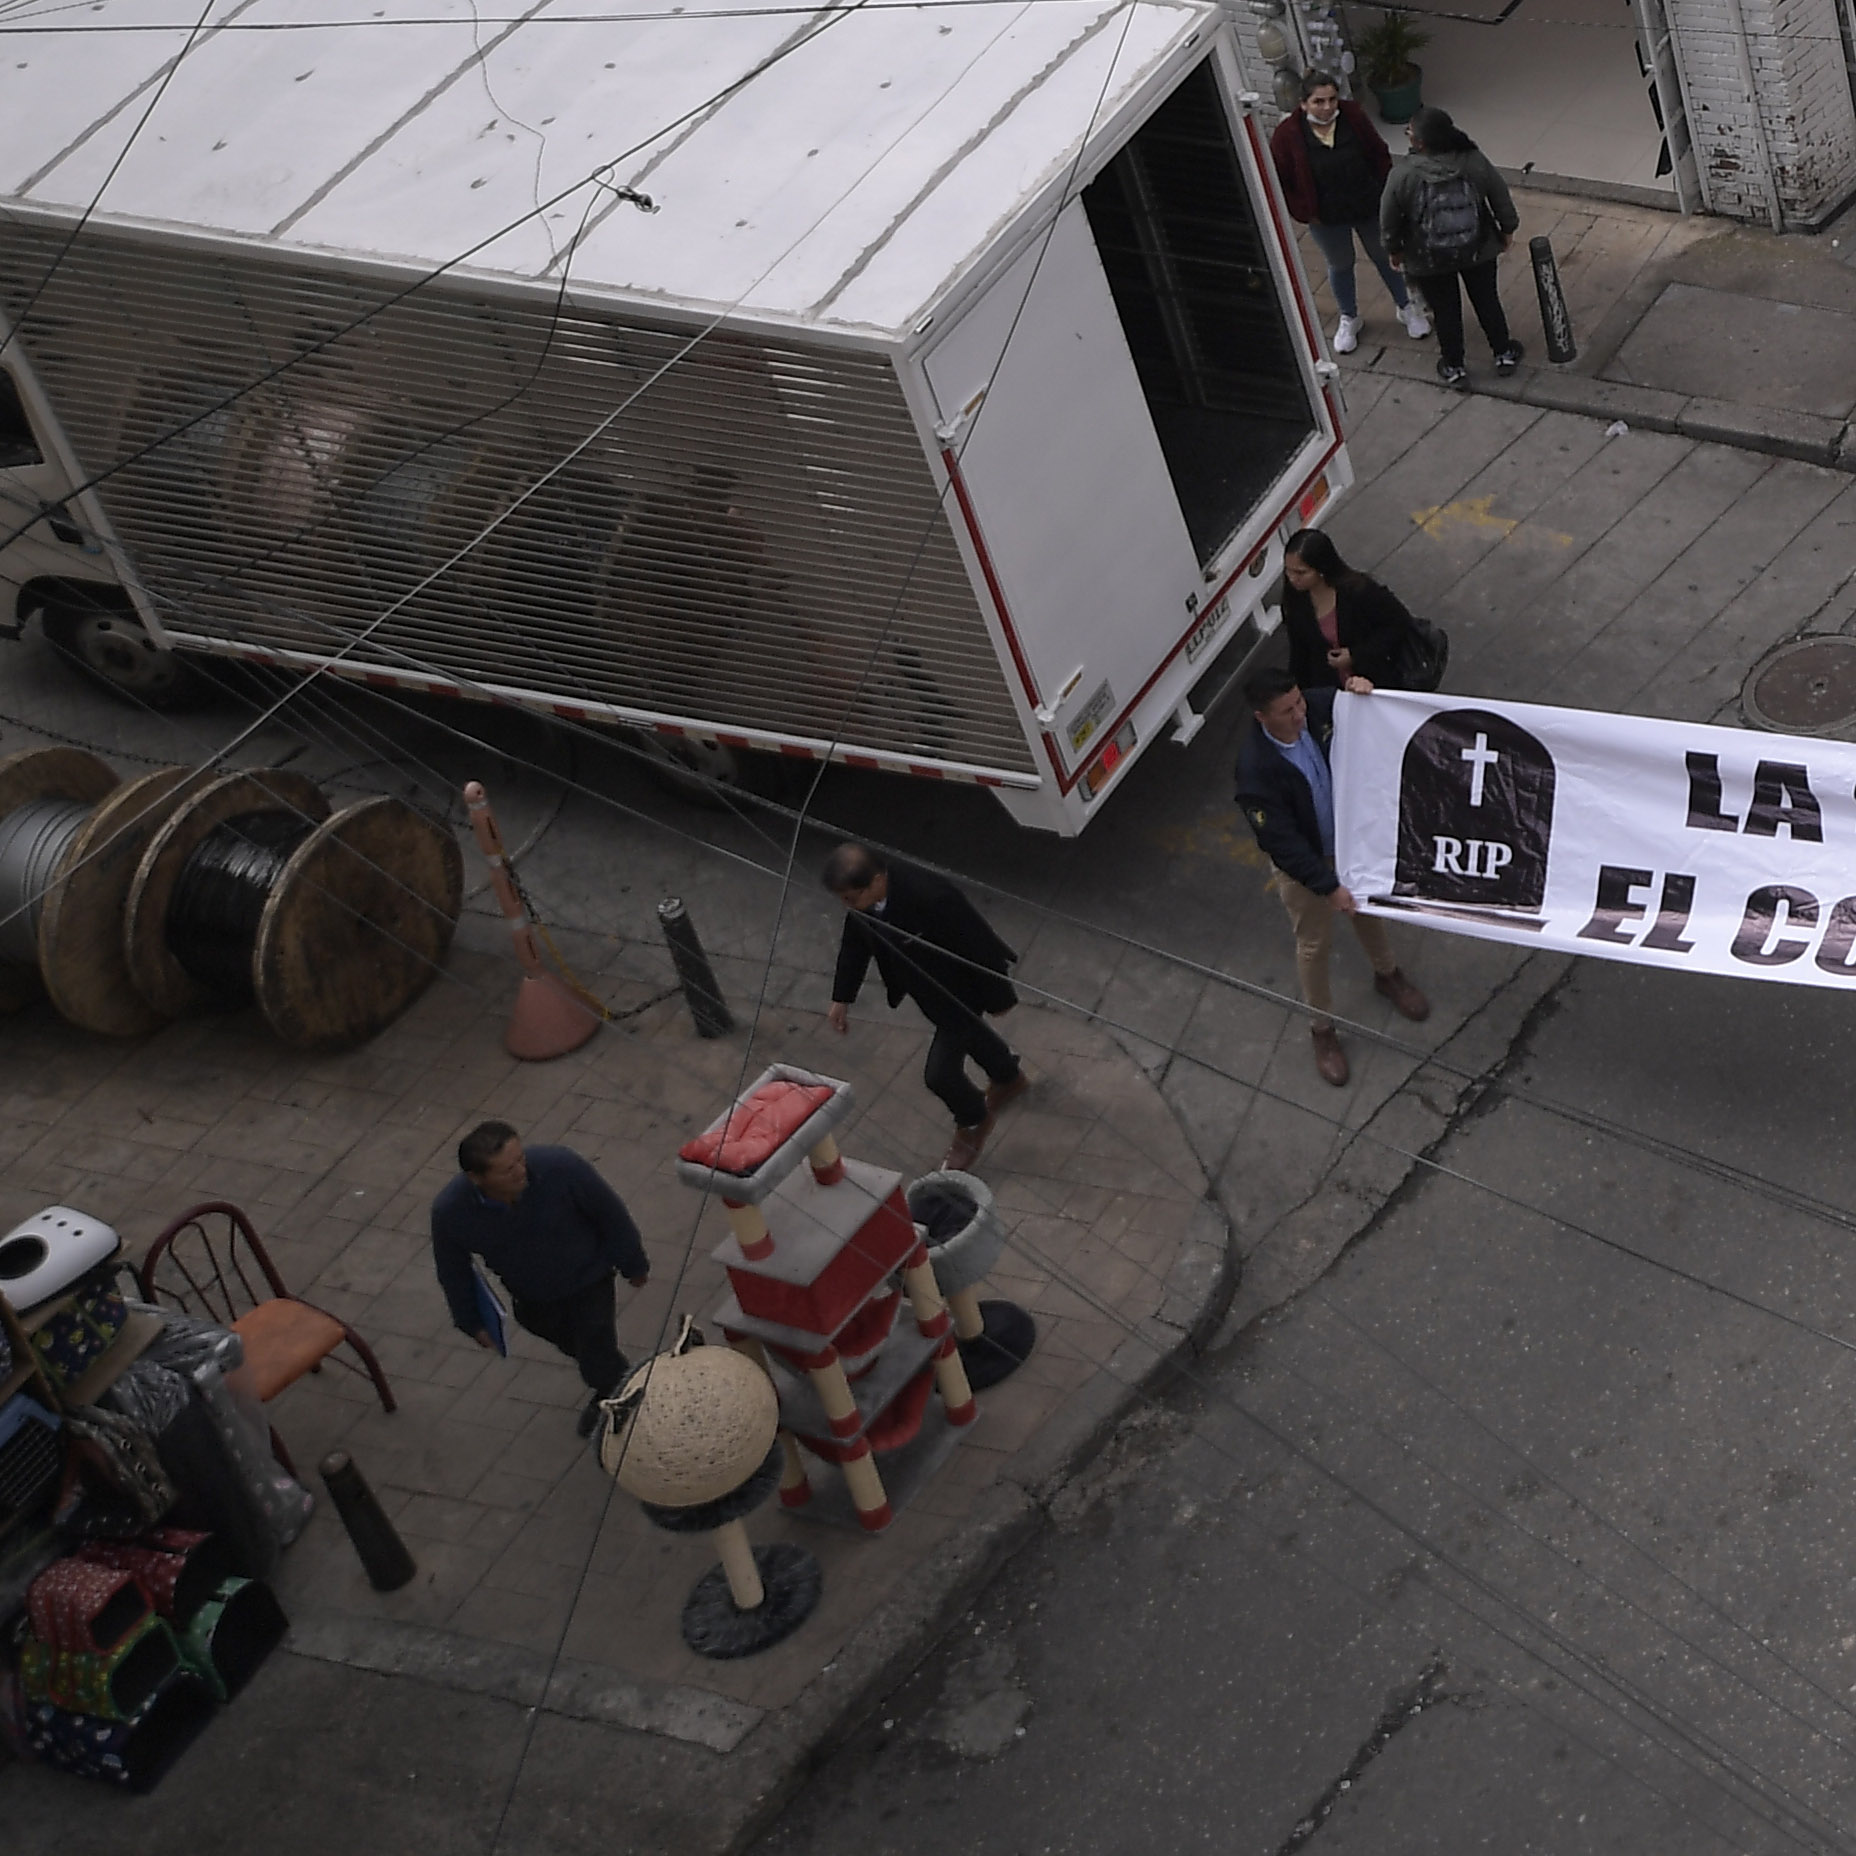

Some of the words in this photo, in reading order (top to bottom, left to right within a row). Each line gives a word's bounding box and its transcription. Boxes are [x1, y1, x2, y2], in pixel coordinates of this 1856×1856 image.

[1684, 750, 1823, 842] LA
[1432, 834, 1514, 881] RIP
[1576, 864, 1698, 956] EL
